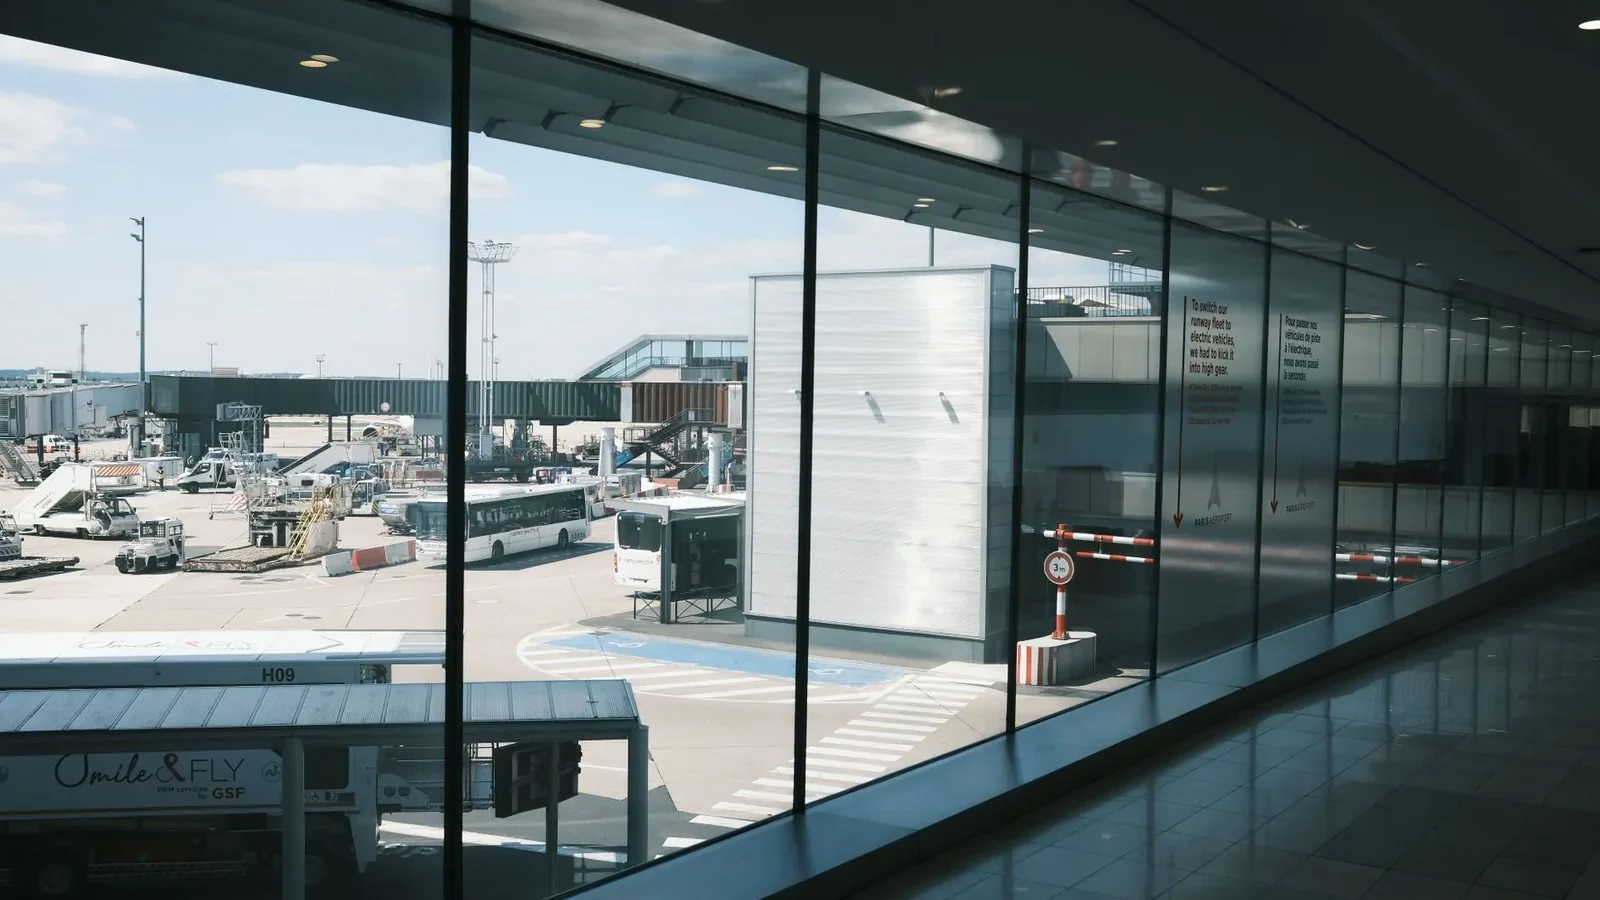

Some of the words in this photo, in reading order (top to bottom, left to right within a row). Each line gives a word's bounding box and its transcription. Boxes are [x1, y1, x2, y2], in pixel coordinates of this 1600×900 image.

[1192, 298, 1198, 311] To
[1200, 300, 1217, 314] switch
[1218, 306, 1228, 314] our
[1191, 317, 1210, 330] runway
[1212, 317, 1224, 330] fleet
[1226, 319, 1231, 330] to
[1190, 330, 1211, 343] electric
[1212, 333, 1235, 348] vehicles,
[1190, 348, 1198, 358] we
[1200, 346, 1210, 359] had
[1211, 348, 1217, 359] to
[1218, 348, 1229, 360] kick
[1230, 348, 1234, 360] it
[1189, 361, 1200, 374] into
[1202, 362, 1214, 376] high
[1215, 366, 1228, 376] gear.
[262, 668, 295, 682] H09
[156, 753, 186, 783] &
[190, 758, 245, 782] FLY
[212, 787, 246, 799] GSF
